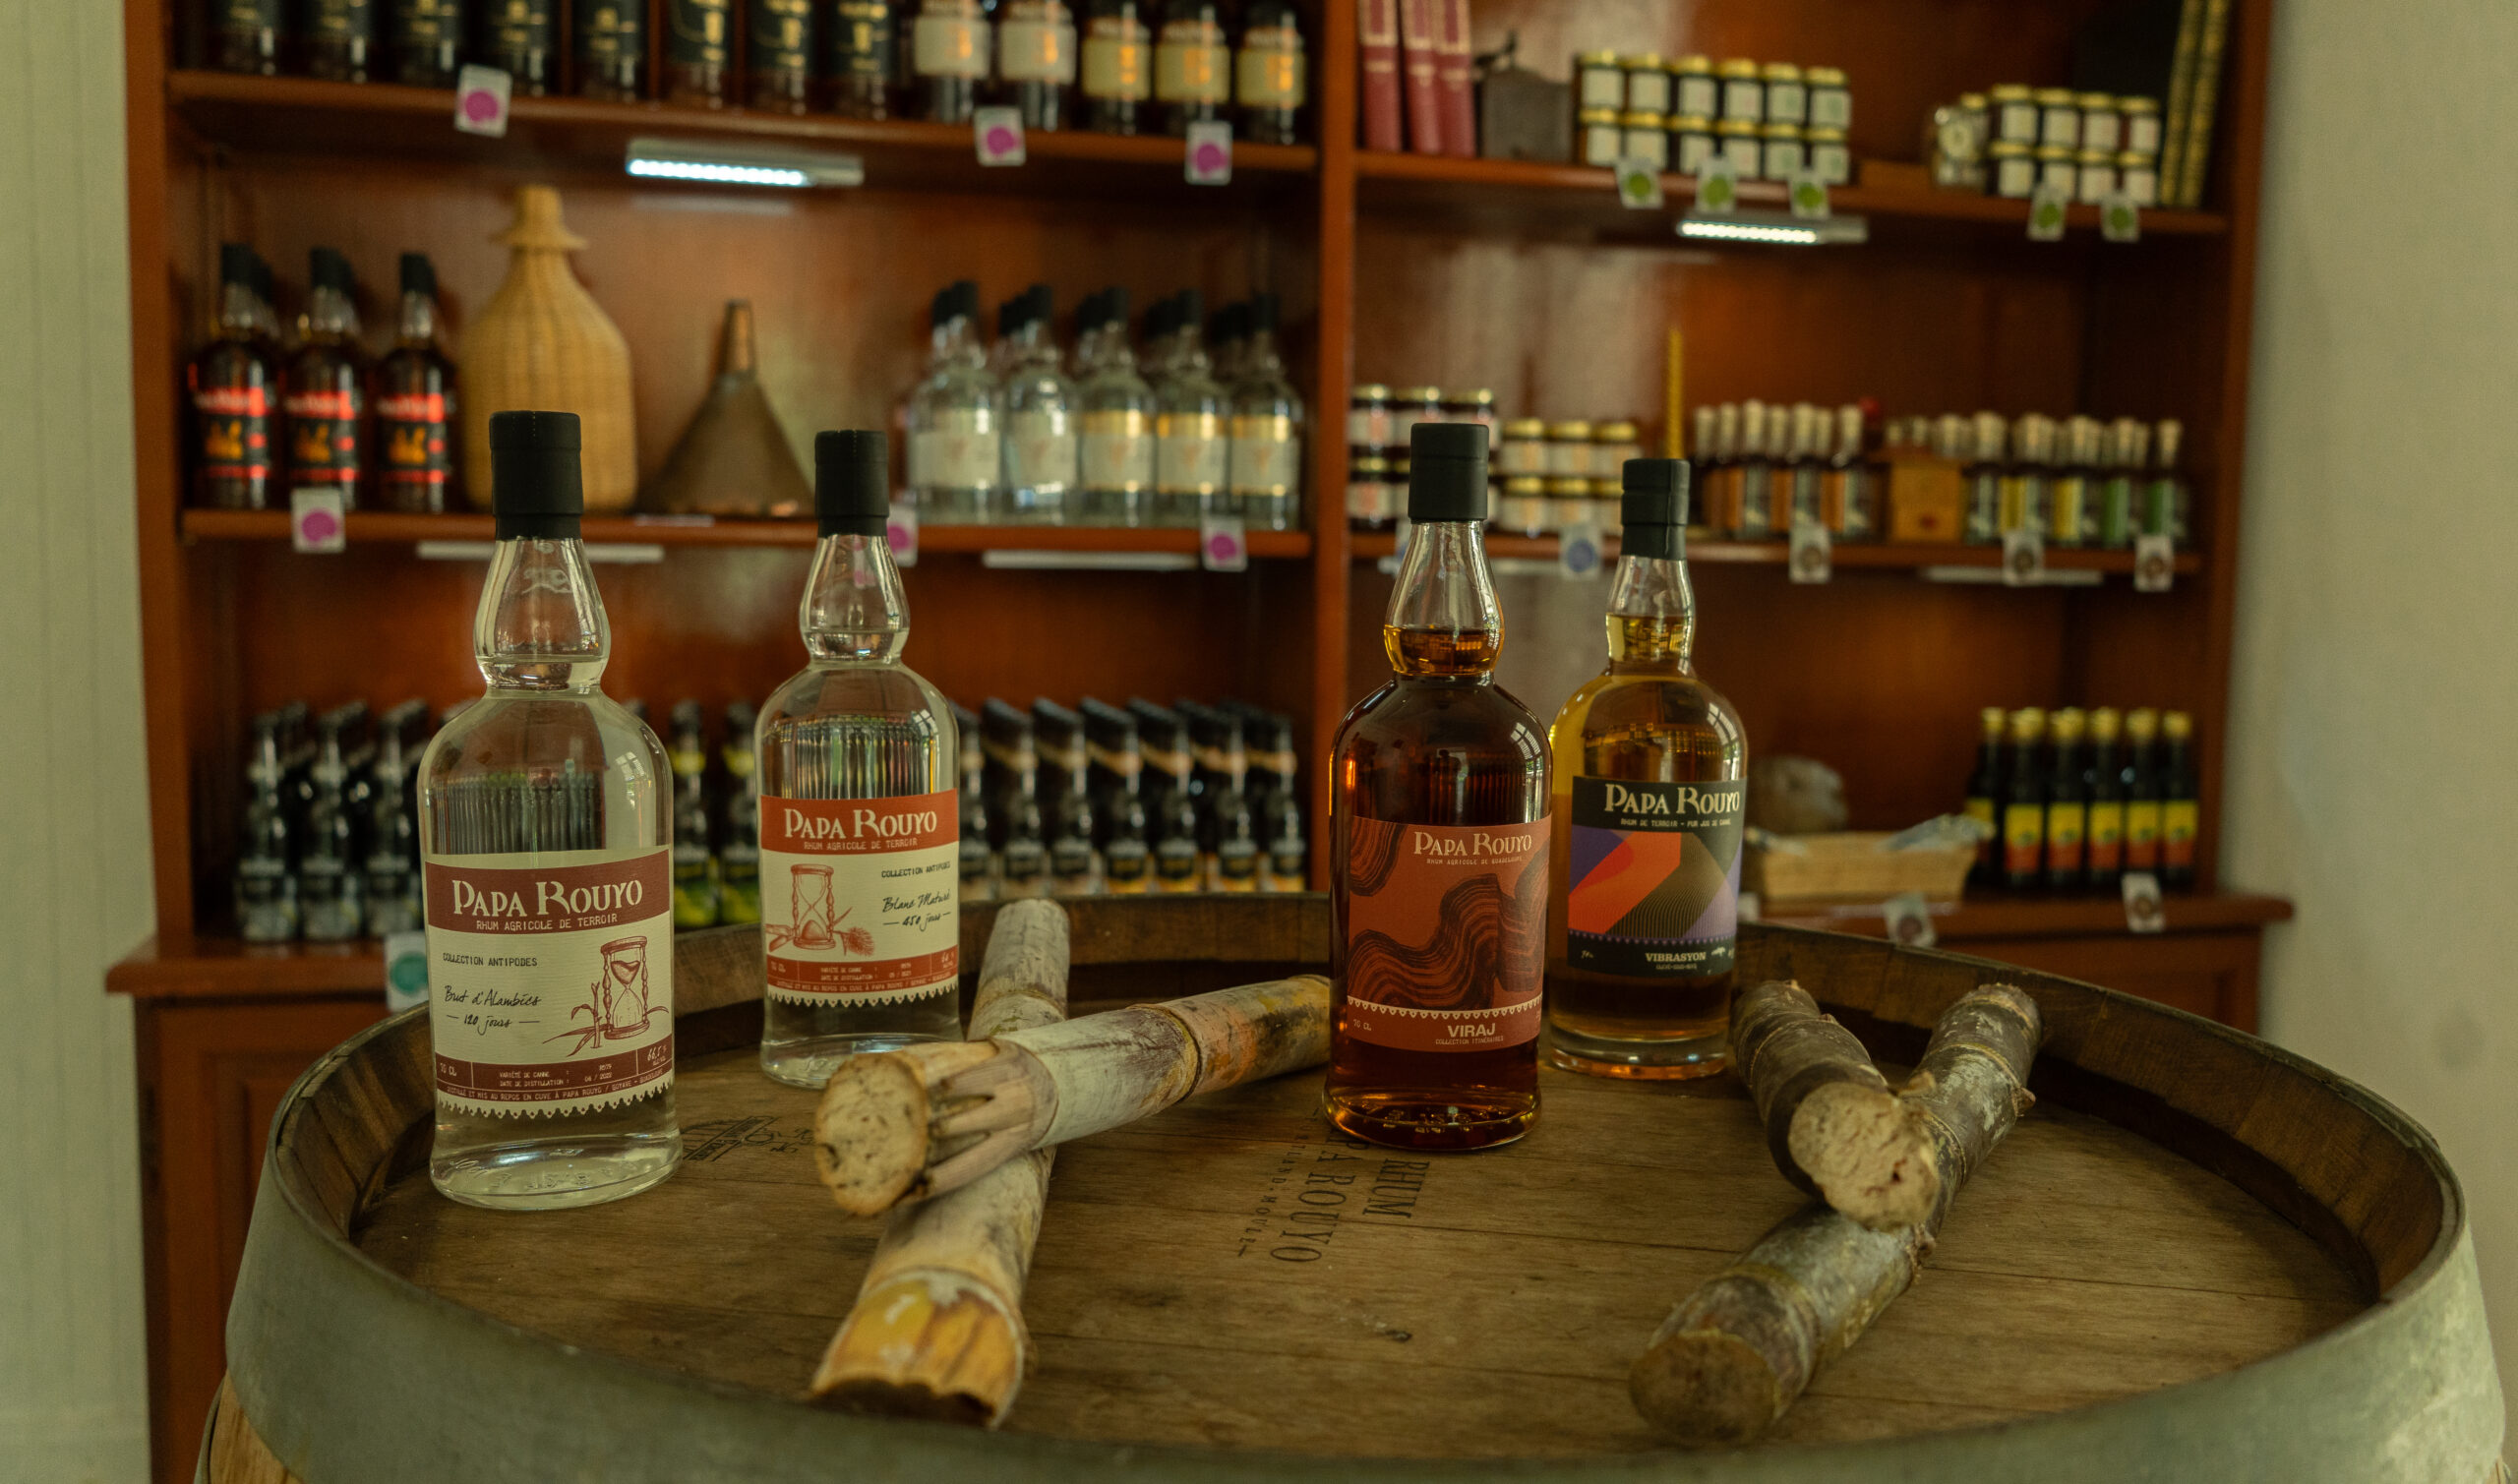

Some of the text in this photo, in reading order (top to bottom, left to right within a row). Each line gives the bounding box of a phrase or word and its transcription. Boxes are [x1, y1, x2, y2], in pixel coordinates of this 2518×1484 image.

[1604, 783, 1740, 814] PAPA ROUYO
[784, 808, 937, 839] PAPA ROUYO
[804, 838, 918, 852] RHUM AGRICOLE DE TERROIR
[1413, 831, 1532, 857] PAPA ROUYO
[881, 867, 924, 878] COLLECTION
[451, 879, 643, 918] PAPA ROUYO
[476, 914, 619, 932] RHUM AGRICOLE DE TERROIR
[443, 952, 538, 968] COLLECTION ANTIPODES
[1645, 951, 1707, 963] VIBRASYON
[444, 985, 469, 1004] Brut
[477, 1014, 512, 1036] jours
[1447, 1023, 1496, 1038] VIRAJ
[534, 1092, 552, 1100] CUVE
[1362, 1158, 1430, 1218] RHUM
[1270, 1171, 1356, 1262] ROUYO
